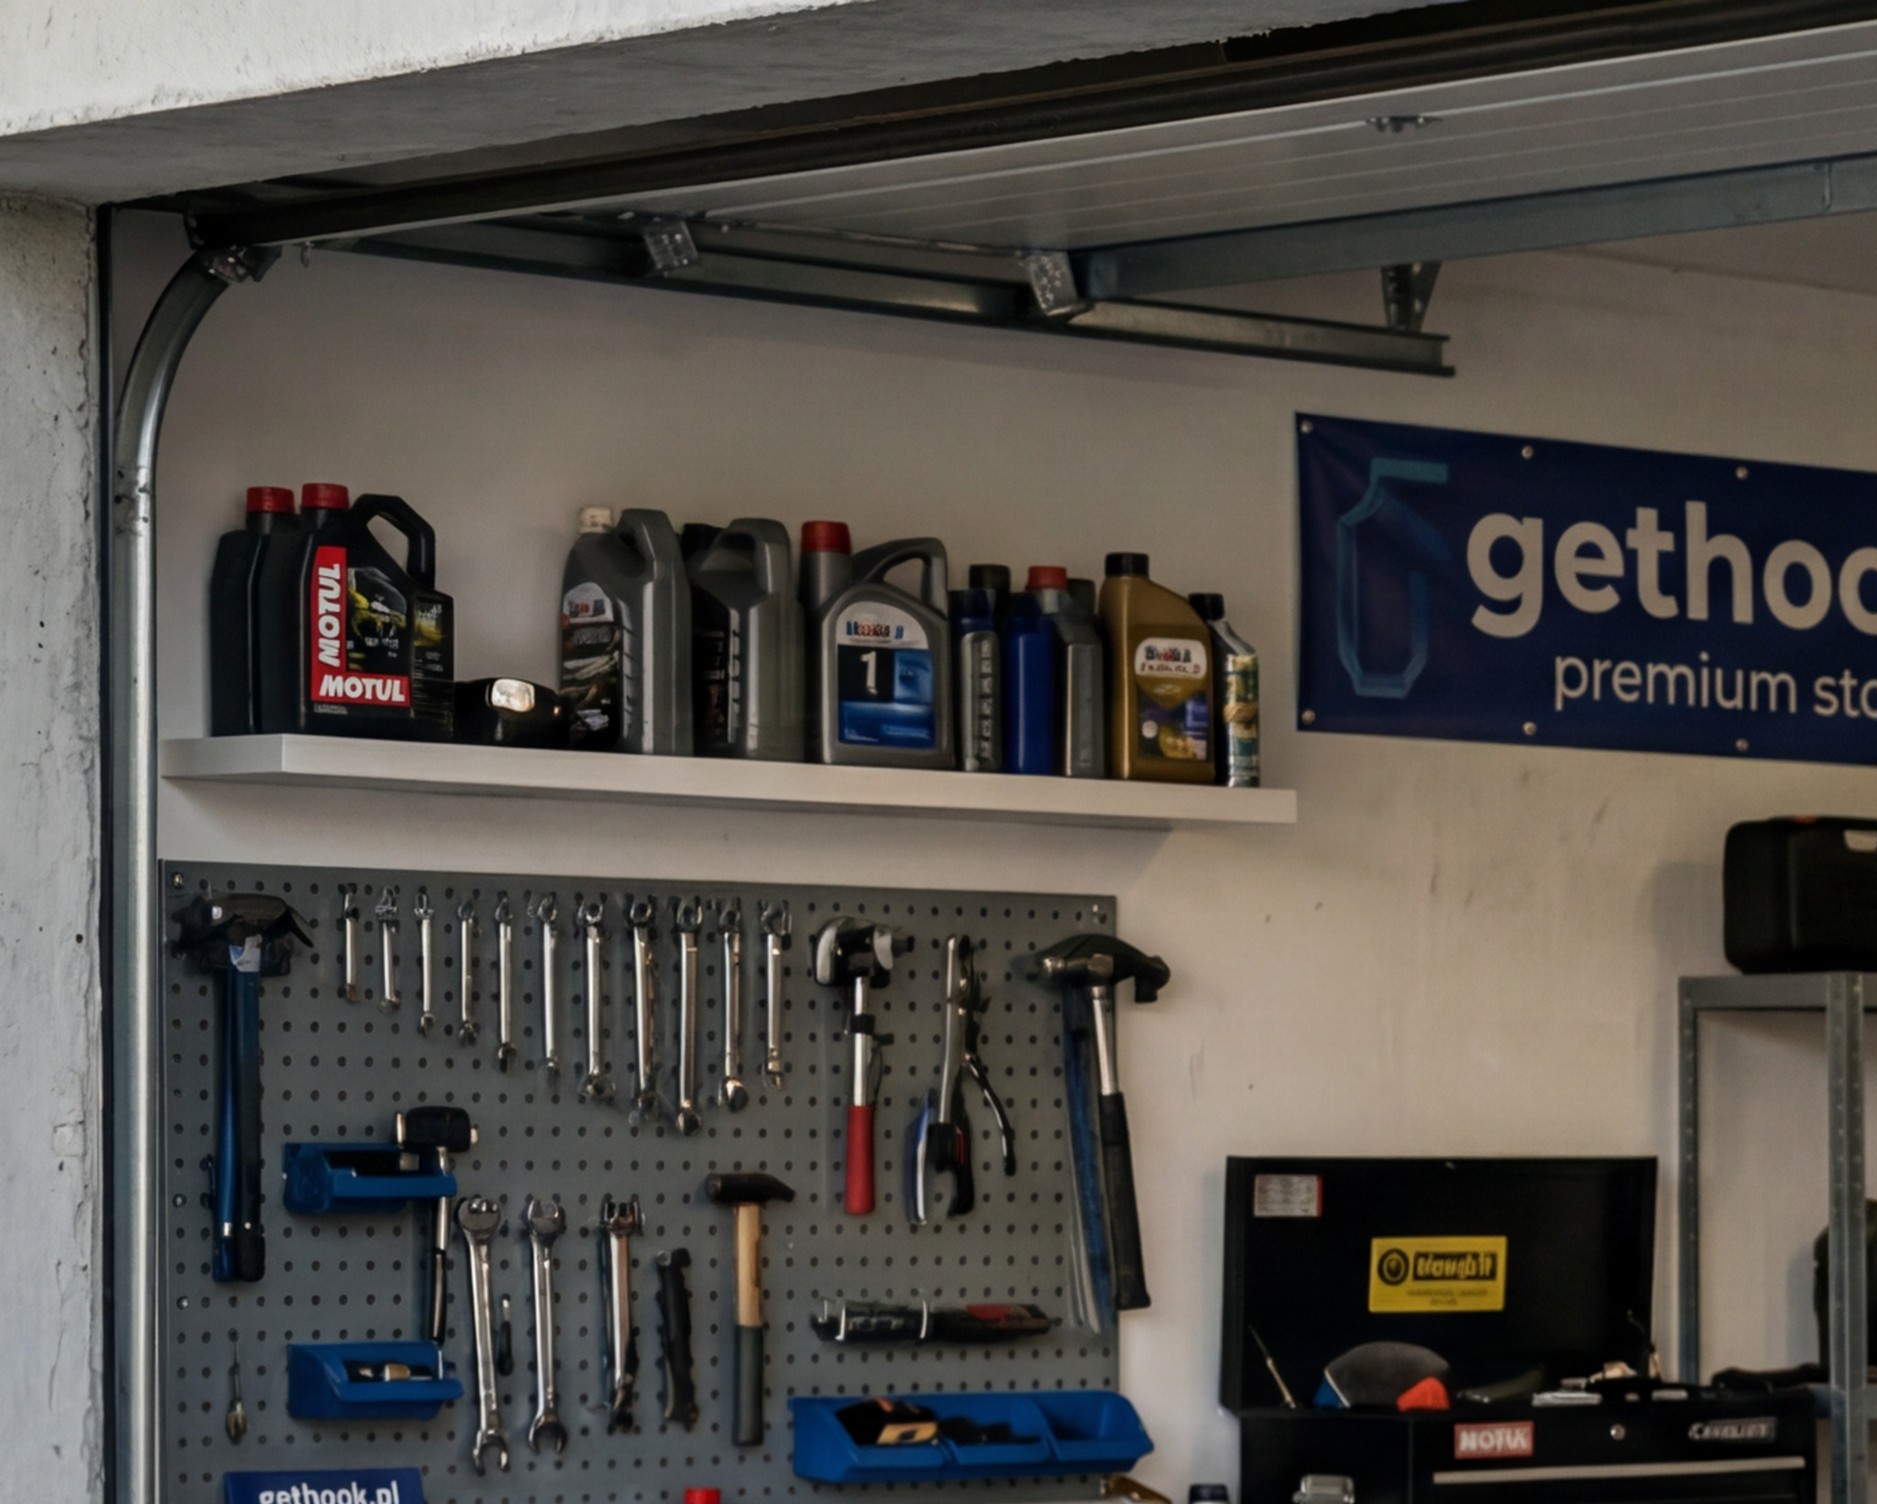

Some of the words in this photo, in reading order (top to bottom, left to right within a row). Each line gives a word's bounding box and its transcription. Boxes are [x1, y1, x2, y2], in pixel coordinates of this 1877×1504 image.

[318, 563, 341, 668] MOTUL
[318, 674, 406, 702] MOTUL
[1554, 651, 1797, 713] premium
